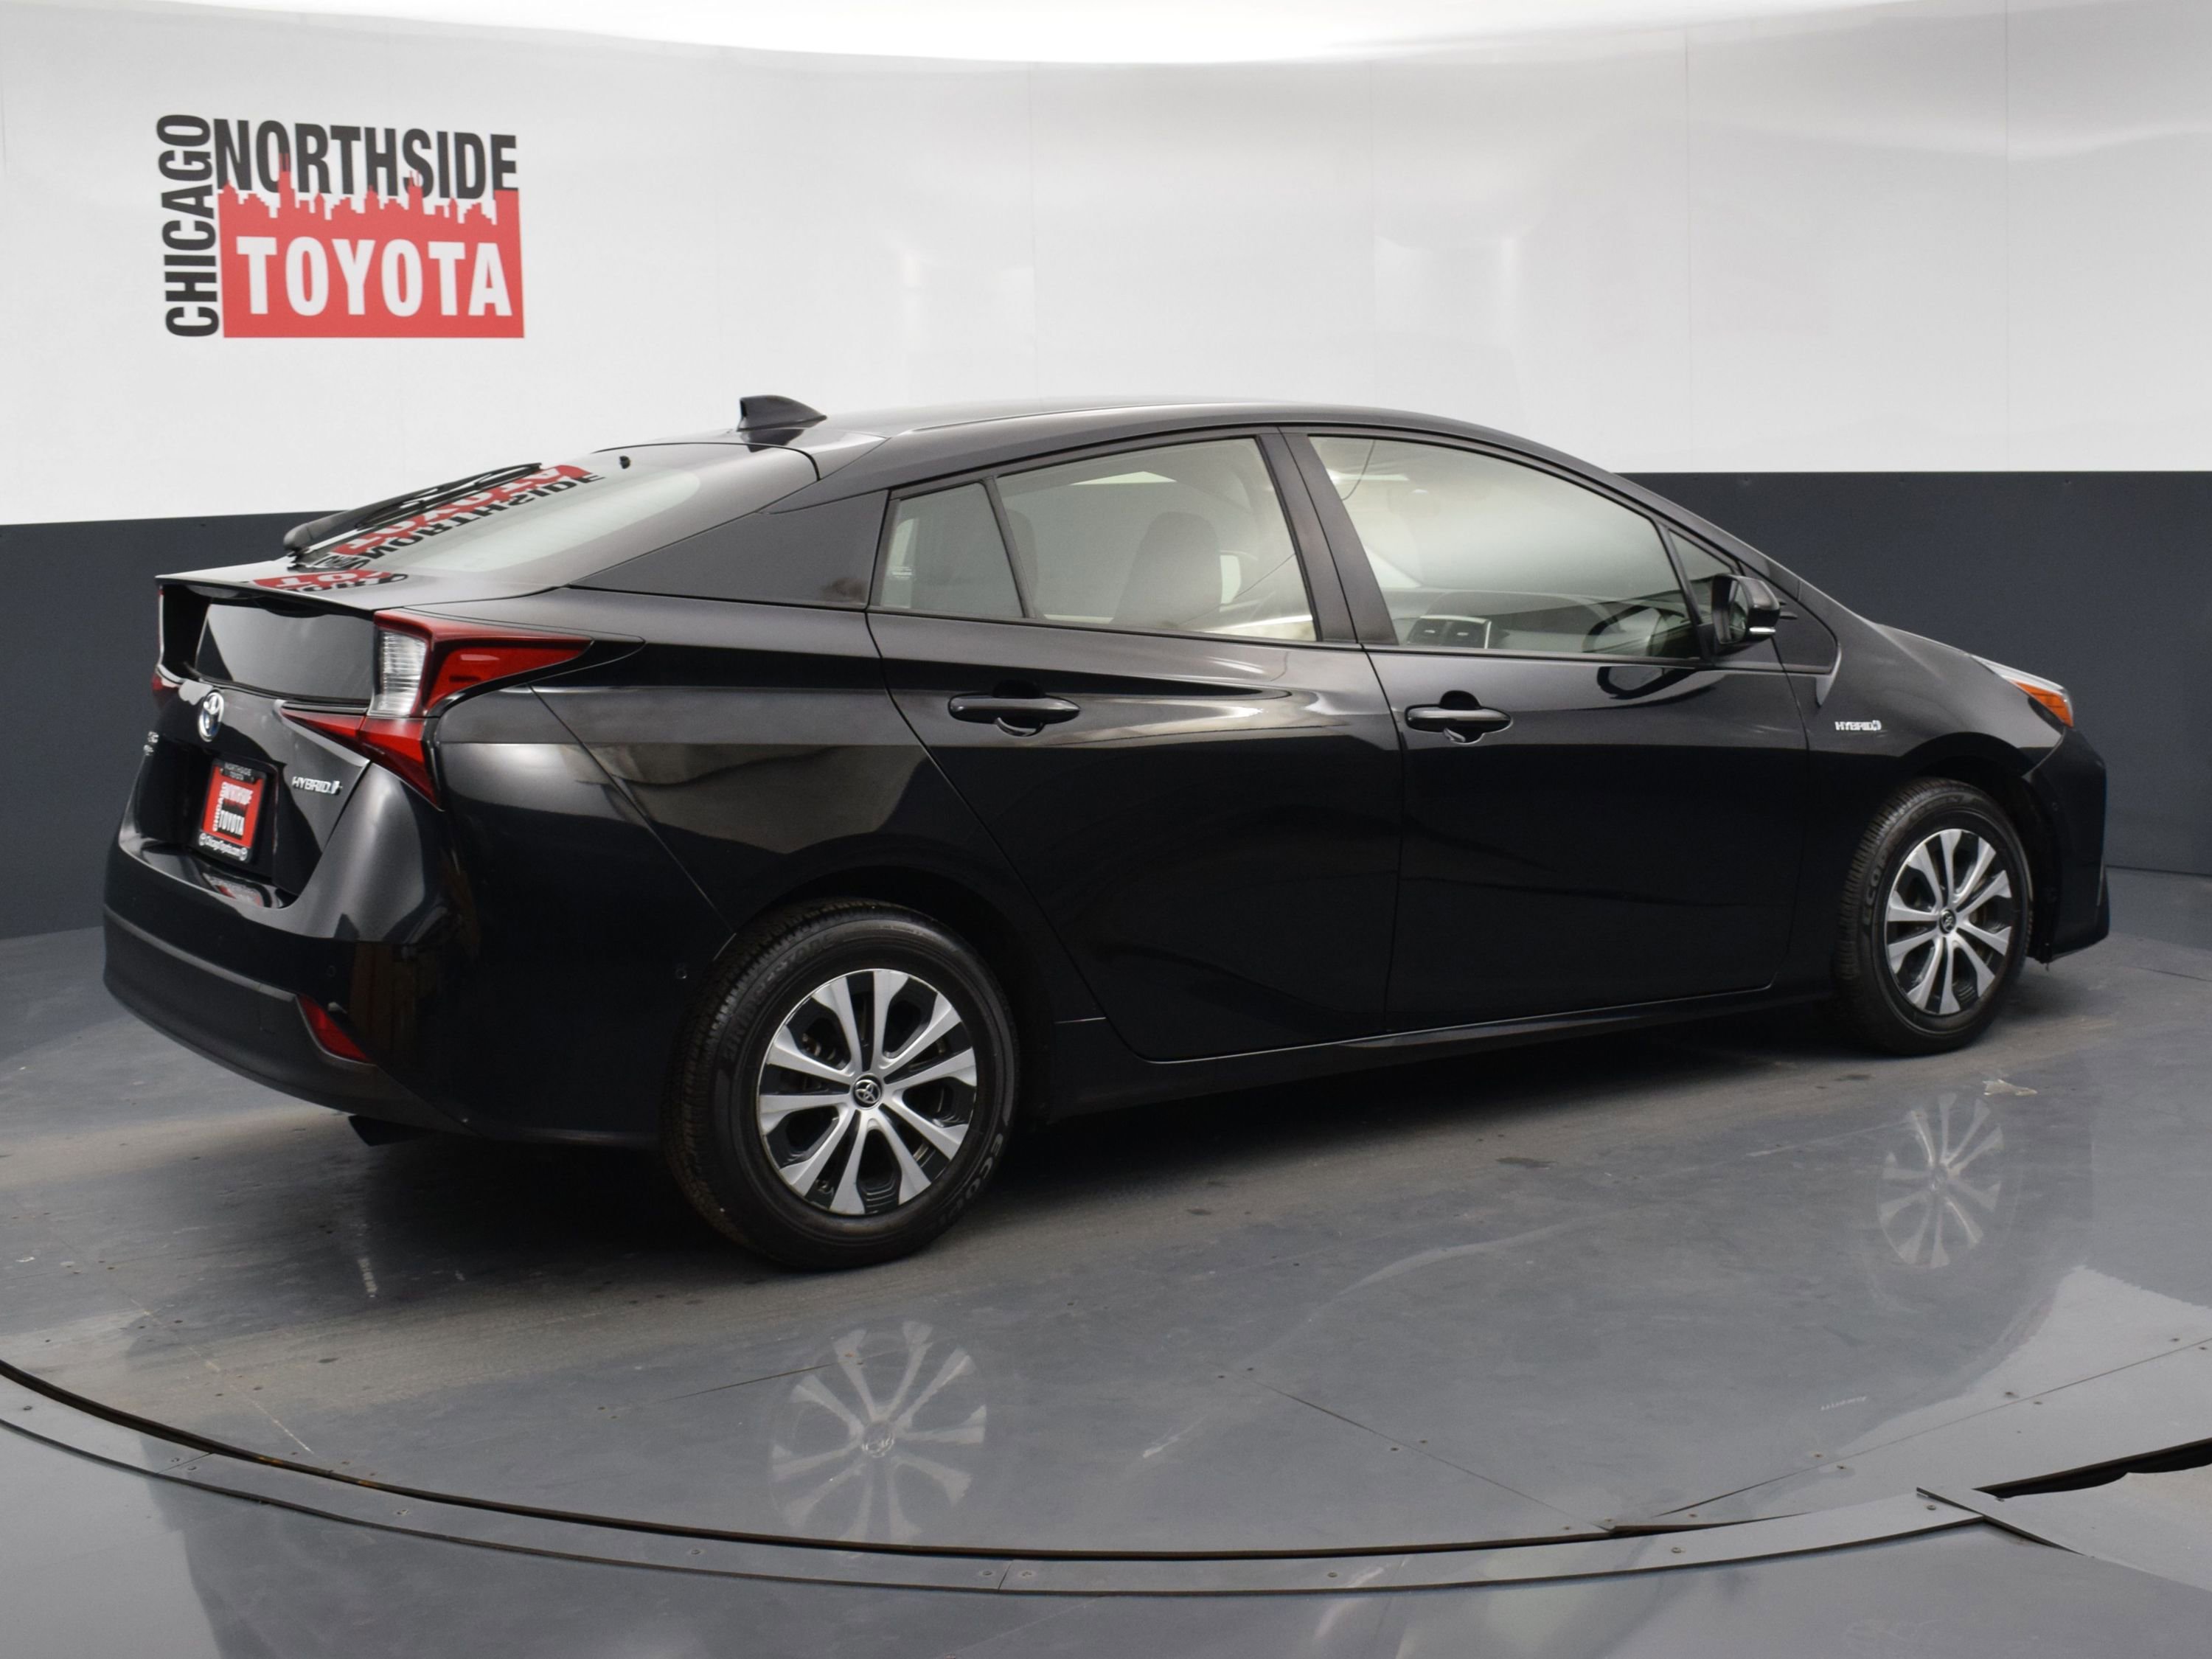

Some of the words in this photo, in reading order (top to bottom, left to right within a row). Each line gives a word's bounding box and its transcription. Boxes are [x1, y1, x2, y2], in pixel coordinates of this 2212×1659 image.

[214, 119, 519, 200] NORTHSIDE
[156, 114, 220, 338] CHICAGO
[236, 236, 513, 318] TOYOTA
[1834, 721, 1874, 731] HYBRID
[291, 776, 332, 793] HYBRID
